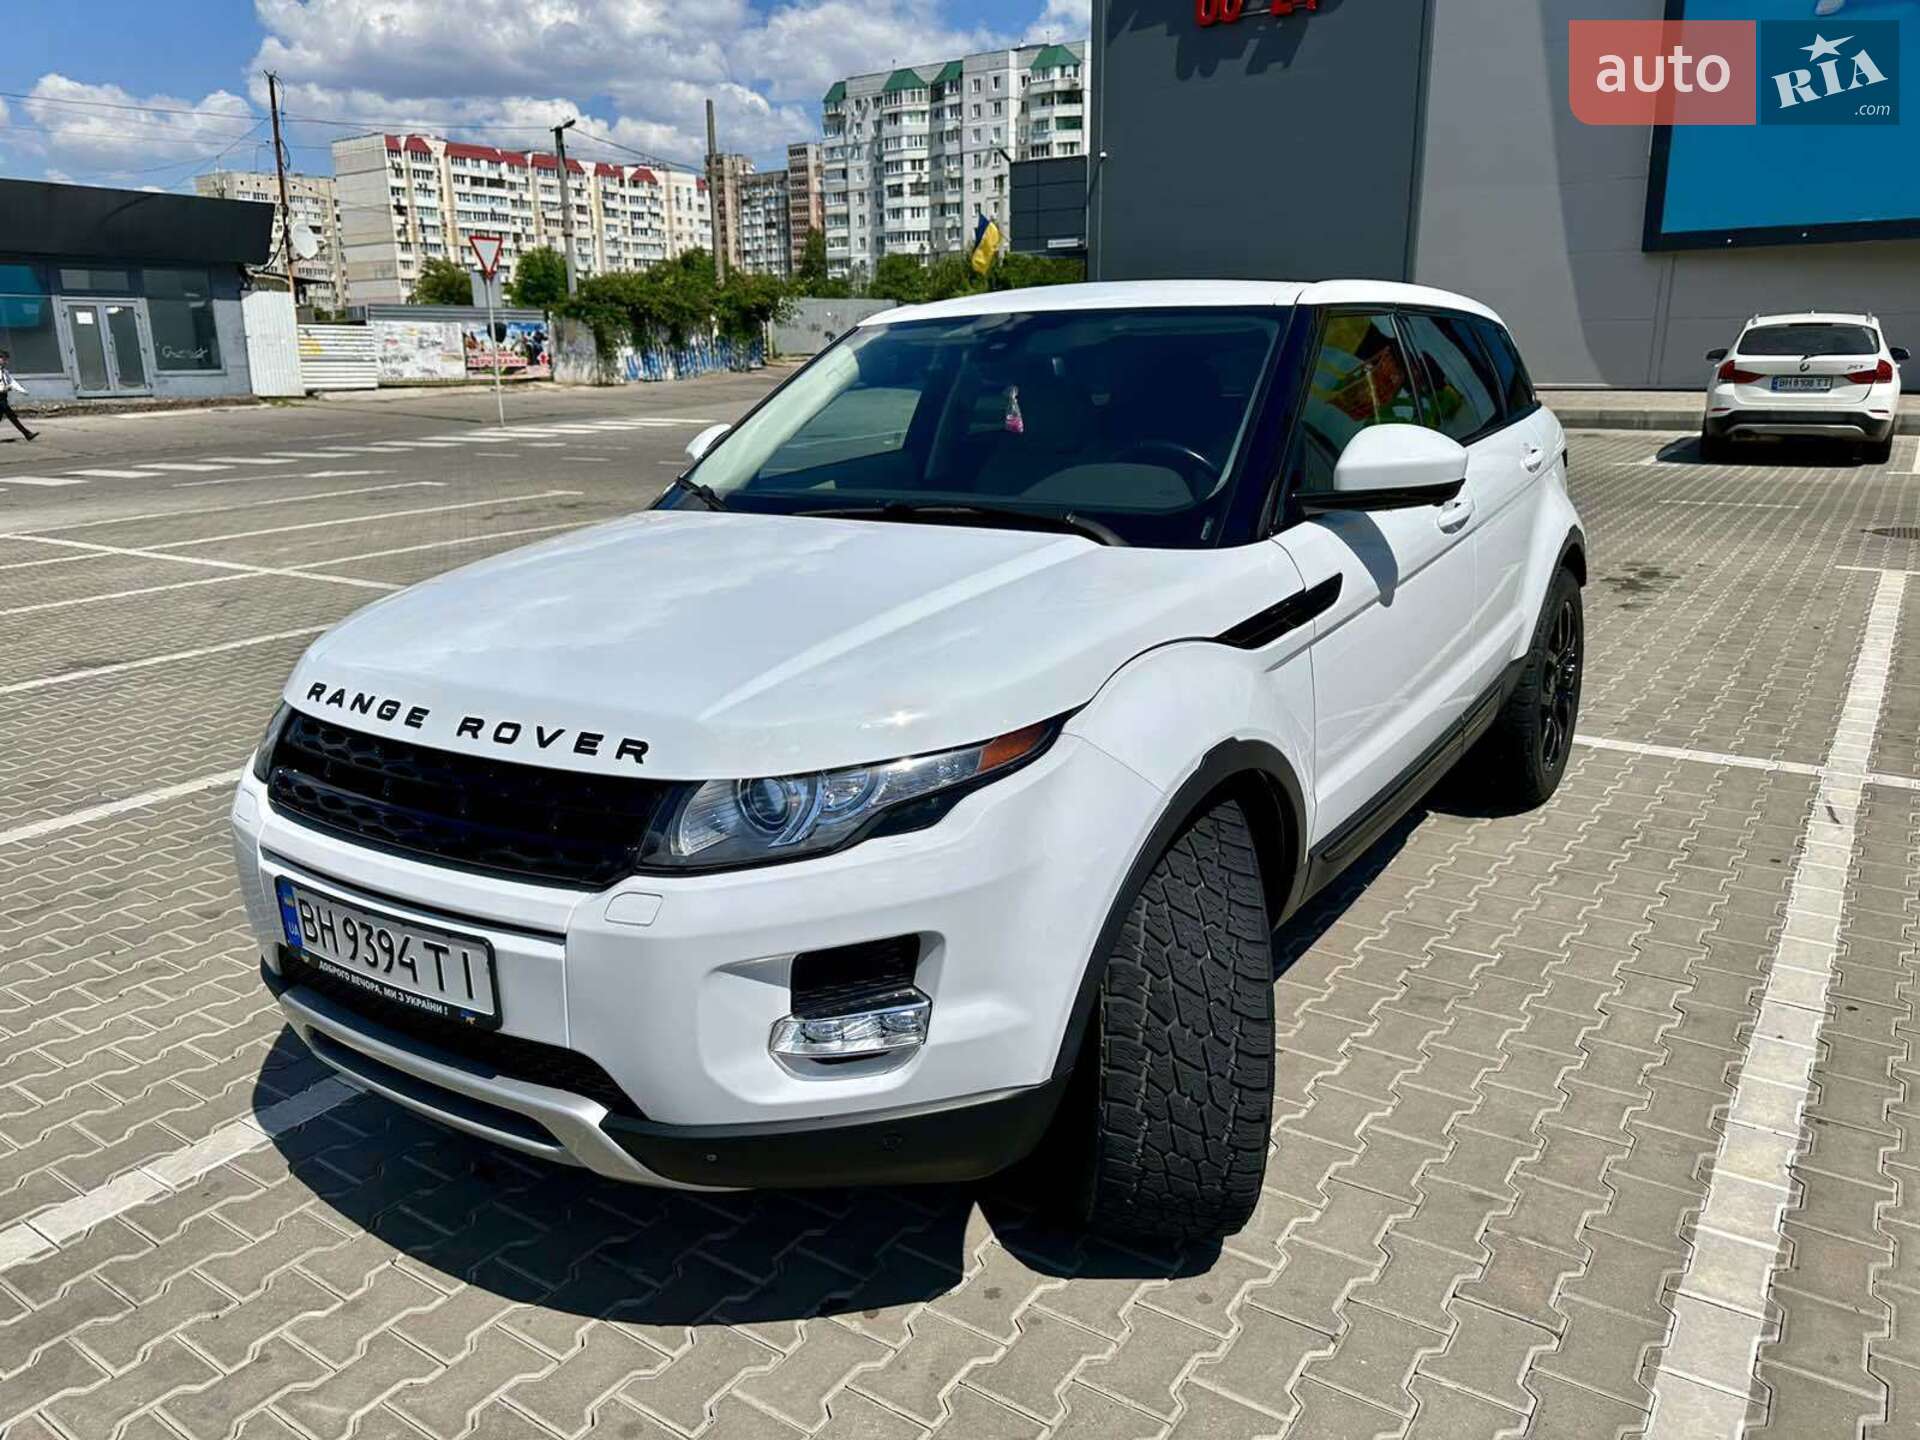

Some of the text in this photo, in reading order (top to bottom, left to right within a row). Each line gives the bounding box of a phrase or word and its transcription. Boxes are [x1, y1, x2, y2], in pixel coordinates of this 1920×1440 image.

[306, 682, 650, 764] RANGE ROVER
[300, 900, 340, 955] BH
[343, 917, 419, 984] 9394
[319, 961, 350, 981] ДОБРОГО
[383, 986, 397, 1000] МИ
